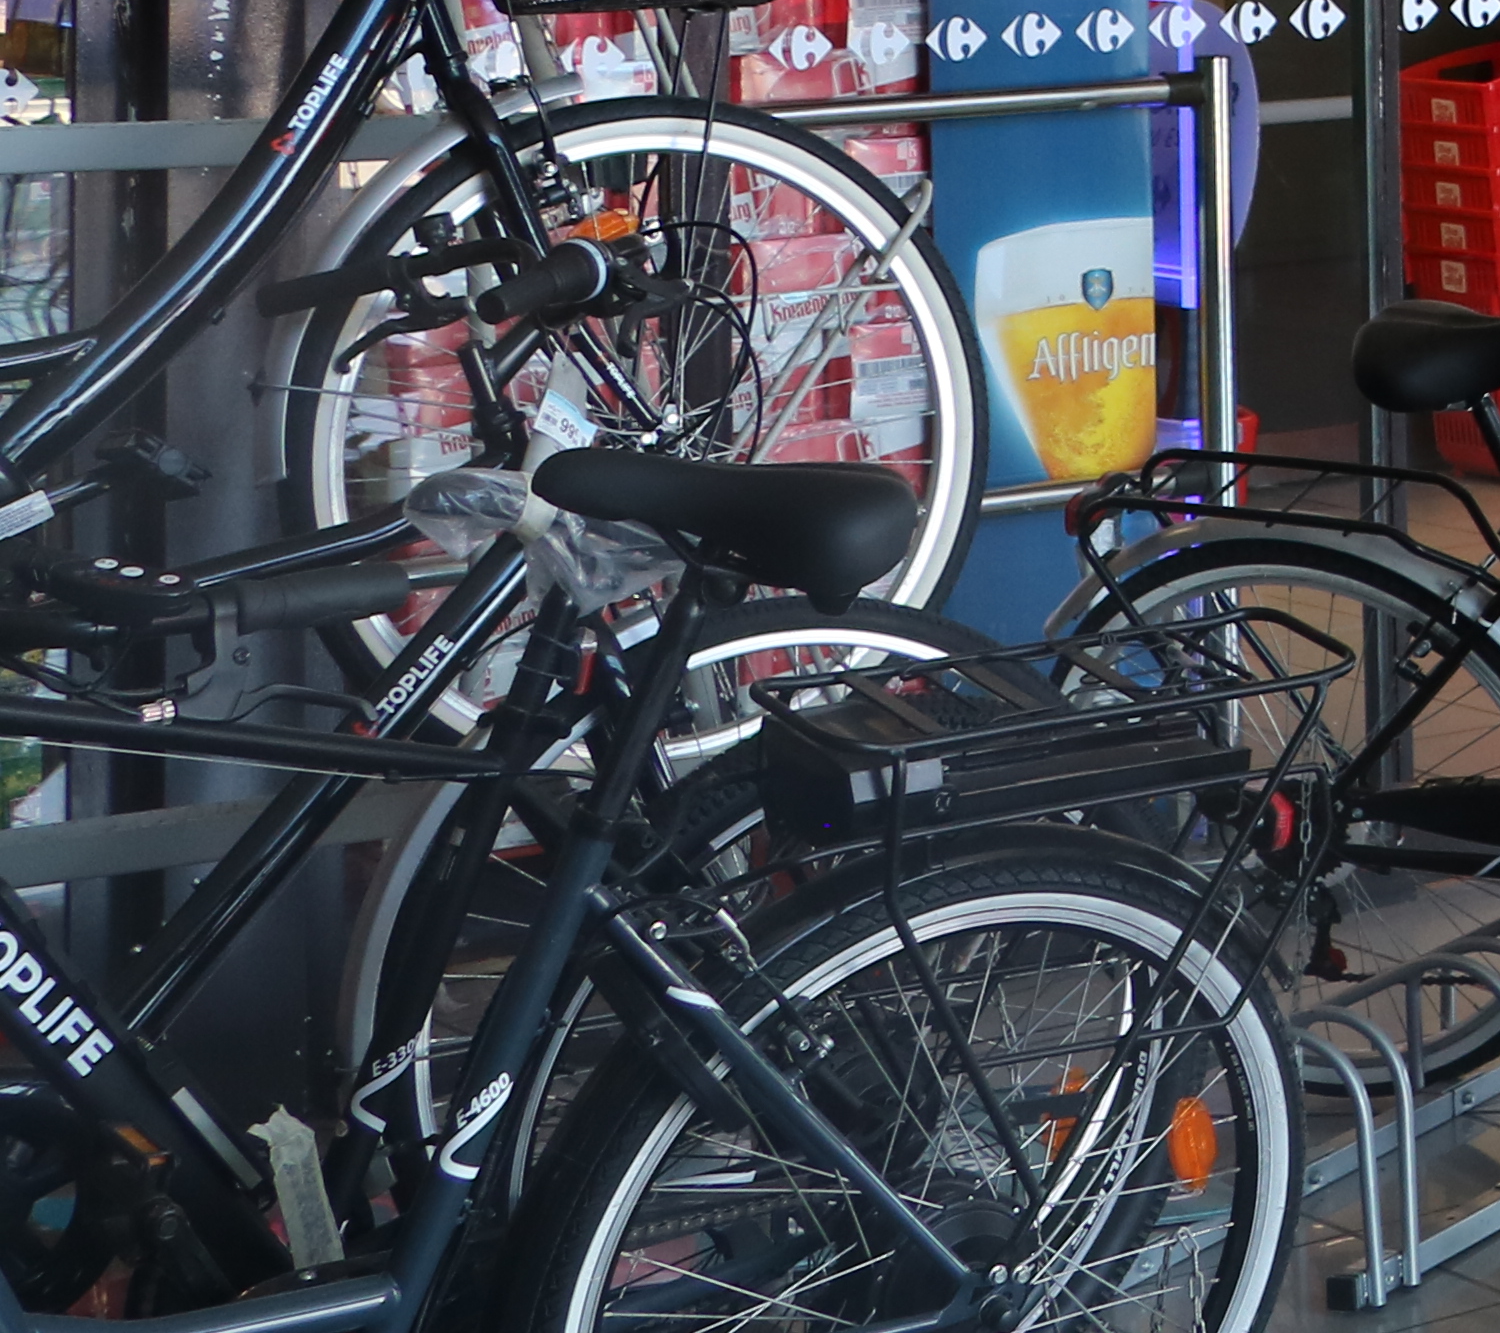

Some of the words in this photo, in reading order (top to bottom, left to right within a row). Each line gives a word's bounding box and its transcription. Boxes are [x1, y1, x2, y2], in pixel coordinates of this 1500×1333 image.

[287, 52, 350, 131] TOPLIFE
[375, 634, 455, 714] TOPLIFE
[0, 931, 115, 1077] OPLIFE
[456, 1071, 511, 1130] E-4600
